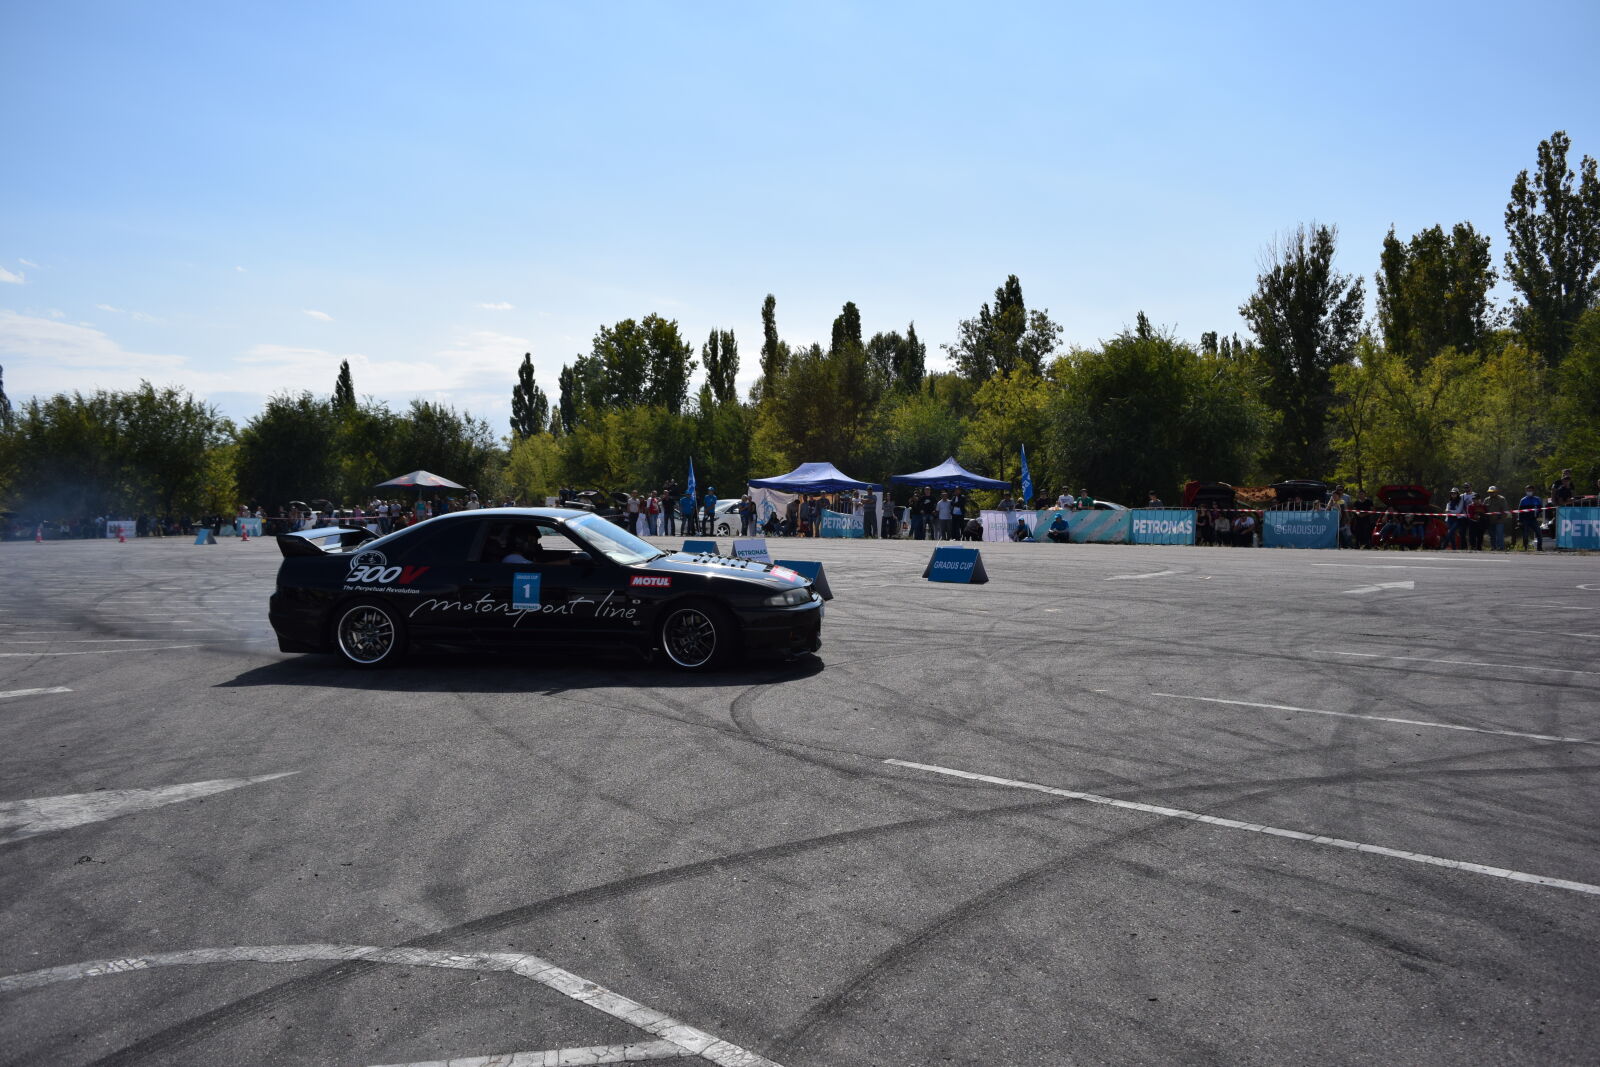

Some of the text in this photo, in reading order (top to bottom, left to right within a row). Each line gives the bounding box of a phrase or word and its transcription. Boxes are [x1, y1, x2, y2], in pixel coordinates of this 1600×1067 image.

[822, 517, 864, 529] PETRONAS
[1132, 519, 1193, 535] PETRONAS
[1273, 524, 1327, 535] @GRADUSCUP
[1561, 519, 1600, 537] PETR
[933, 560, 974, 570] GRADUS CUP
[345, 564, 430, 585] 300V
[632, 576, 670, 586] MOTUL
[354, 585, 386, 593] Perpetual
[385, 586, 420, 594] Revolution
[522, 583, 530, 599] 1
[594, 589, 637, 619] line
